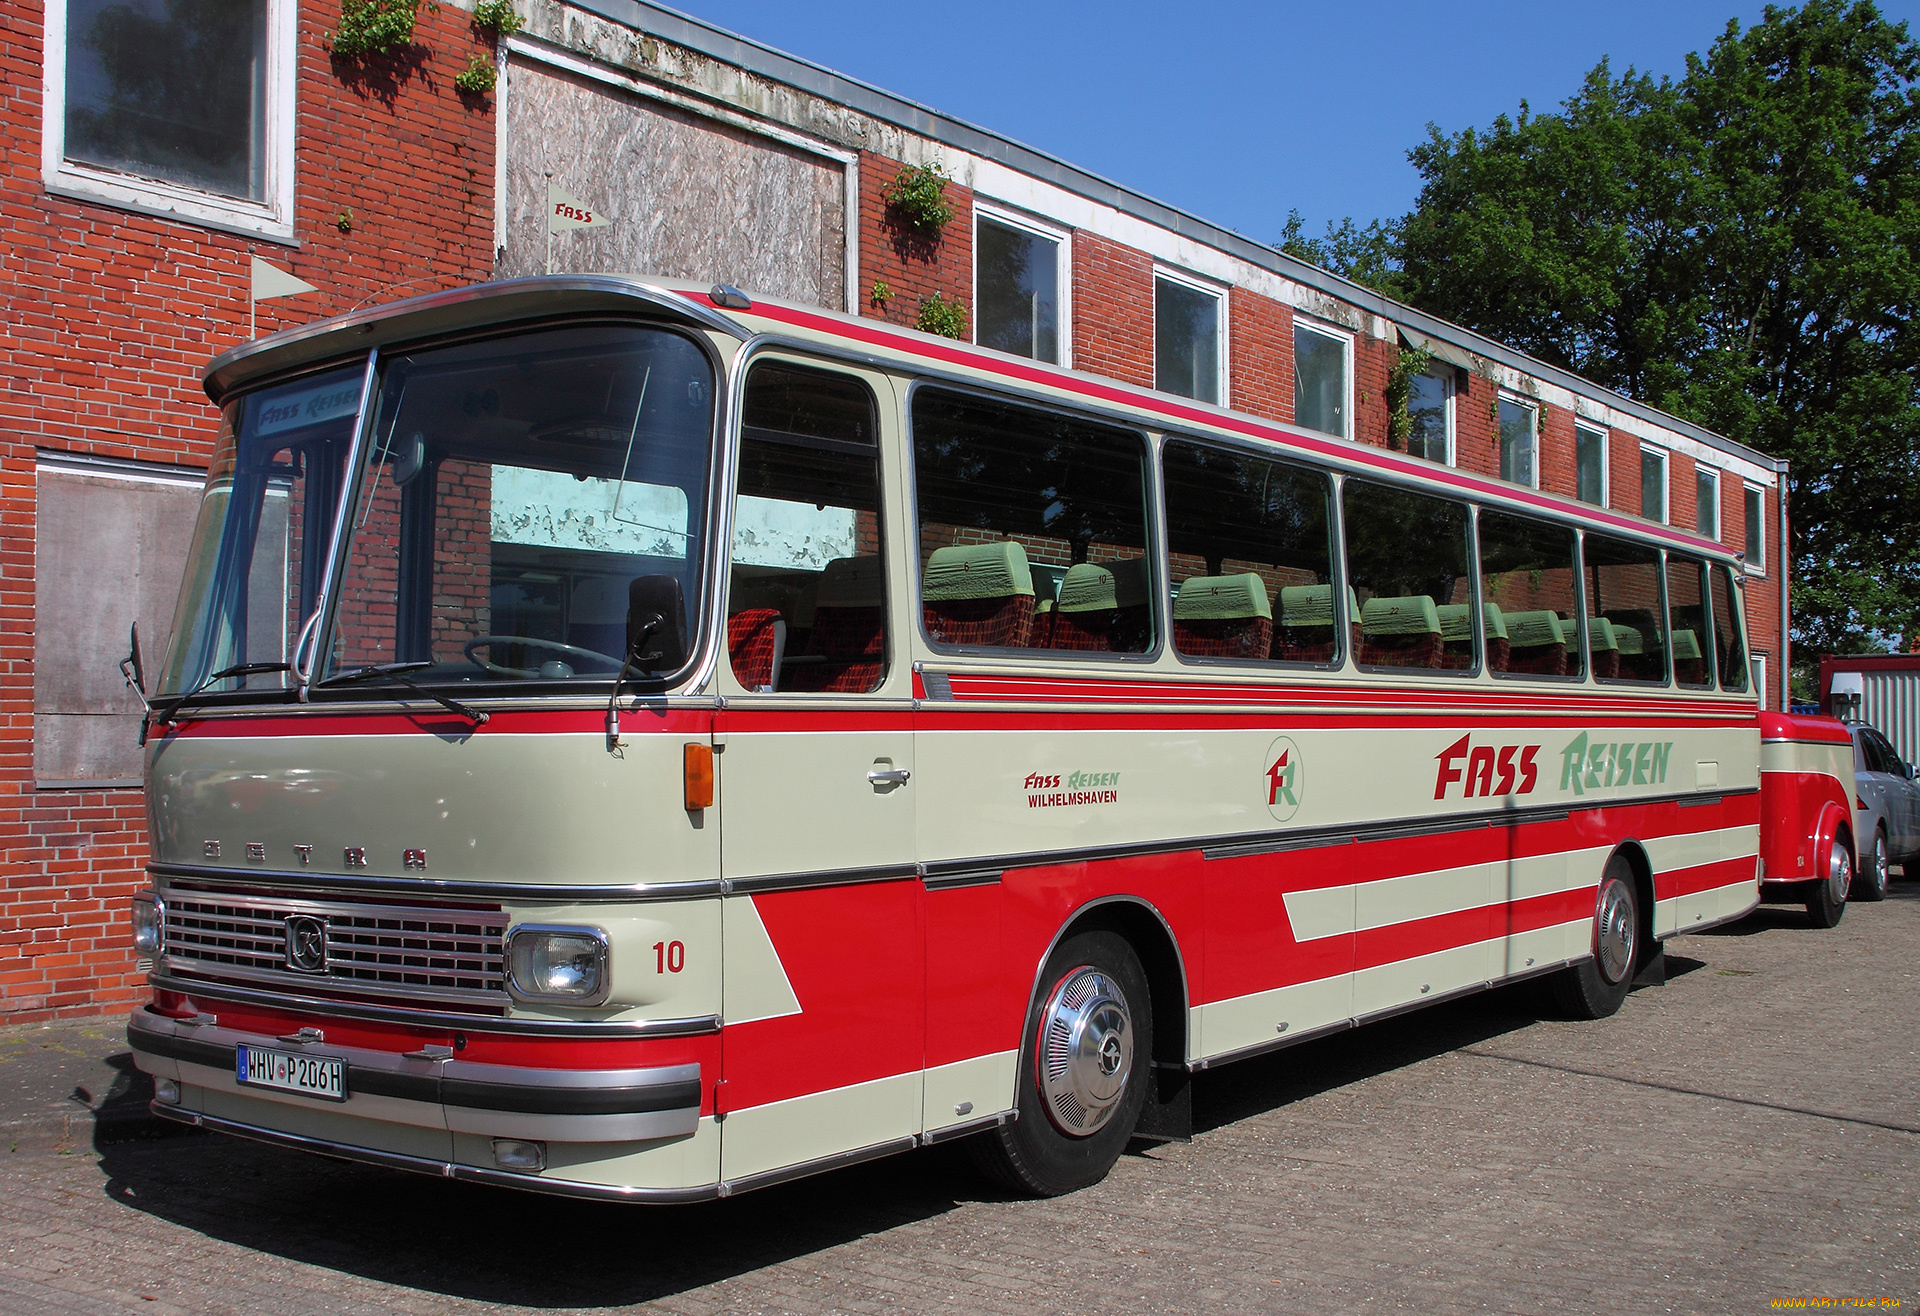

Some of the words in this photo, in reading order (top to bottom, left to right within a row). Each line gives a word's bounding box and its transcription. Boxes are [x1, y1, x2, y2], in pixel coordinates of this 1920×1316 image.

[555, 203, 592, 223] FASS
[260, 403, 300, 426] FASS
[964, 561, 970, 572] 6
[1098, 574, 1107, 584] 10
[1390, 606, 1399, 615] 22
[1433, 731, 1541, 800] FASS
[1560, 730, 1673, 796] REISEN
[1023, 771, 1061, 790] FASS
[1067, 769, 1121, 790] REISEN
[1028, 790, 1117, 808] WILHELMSHAVEN
[203, 839, 428, 872] SETRA
[652, 940, 685, 974] 10
[248, 1050, 276, 1081] WHV
